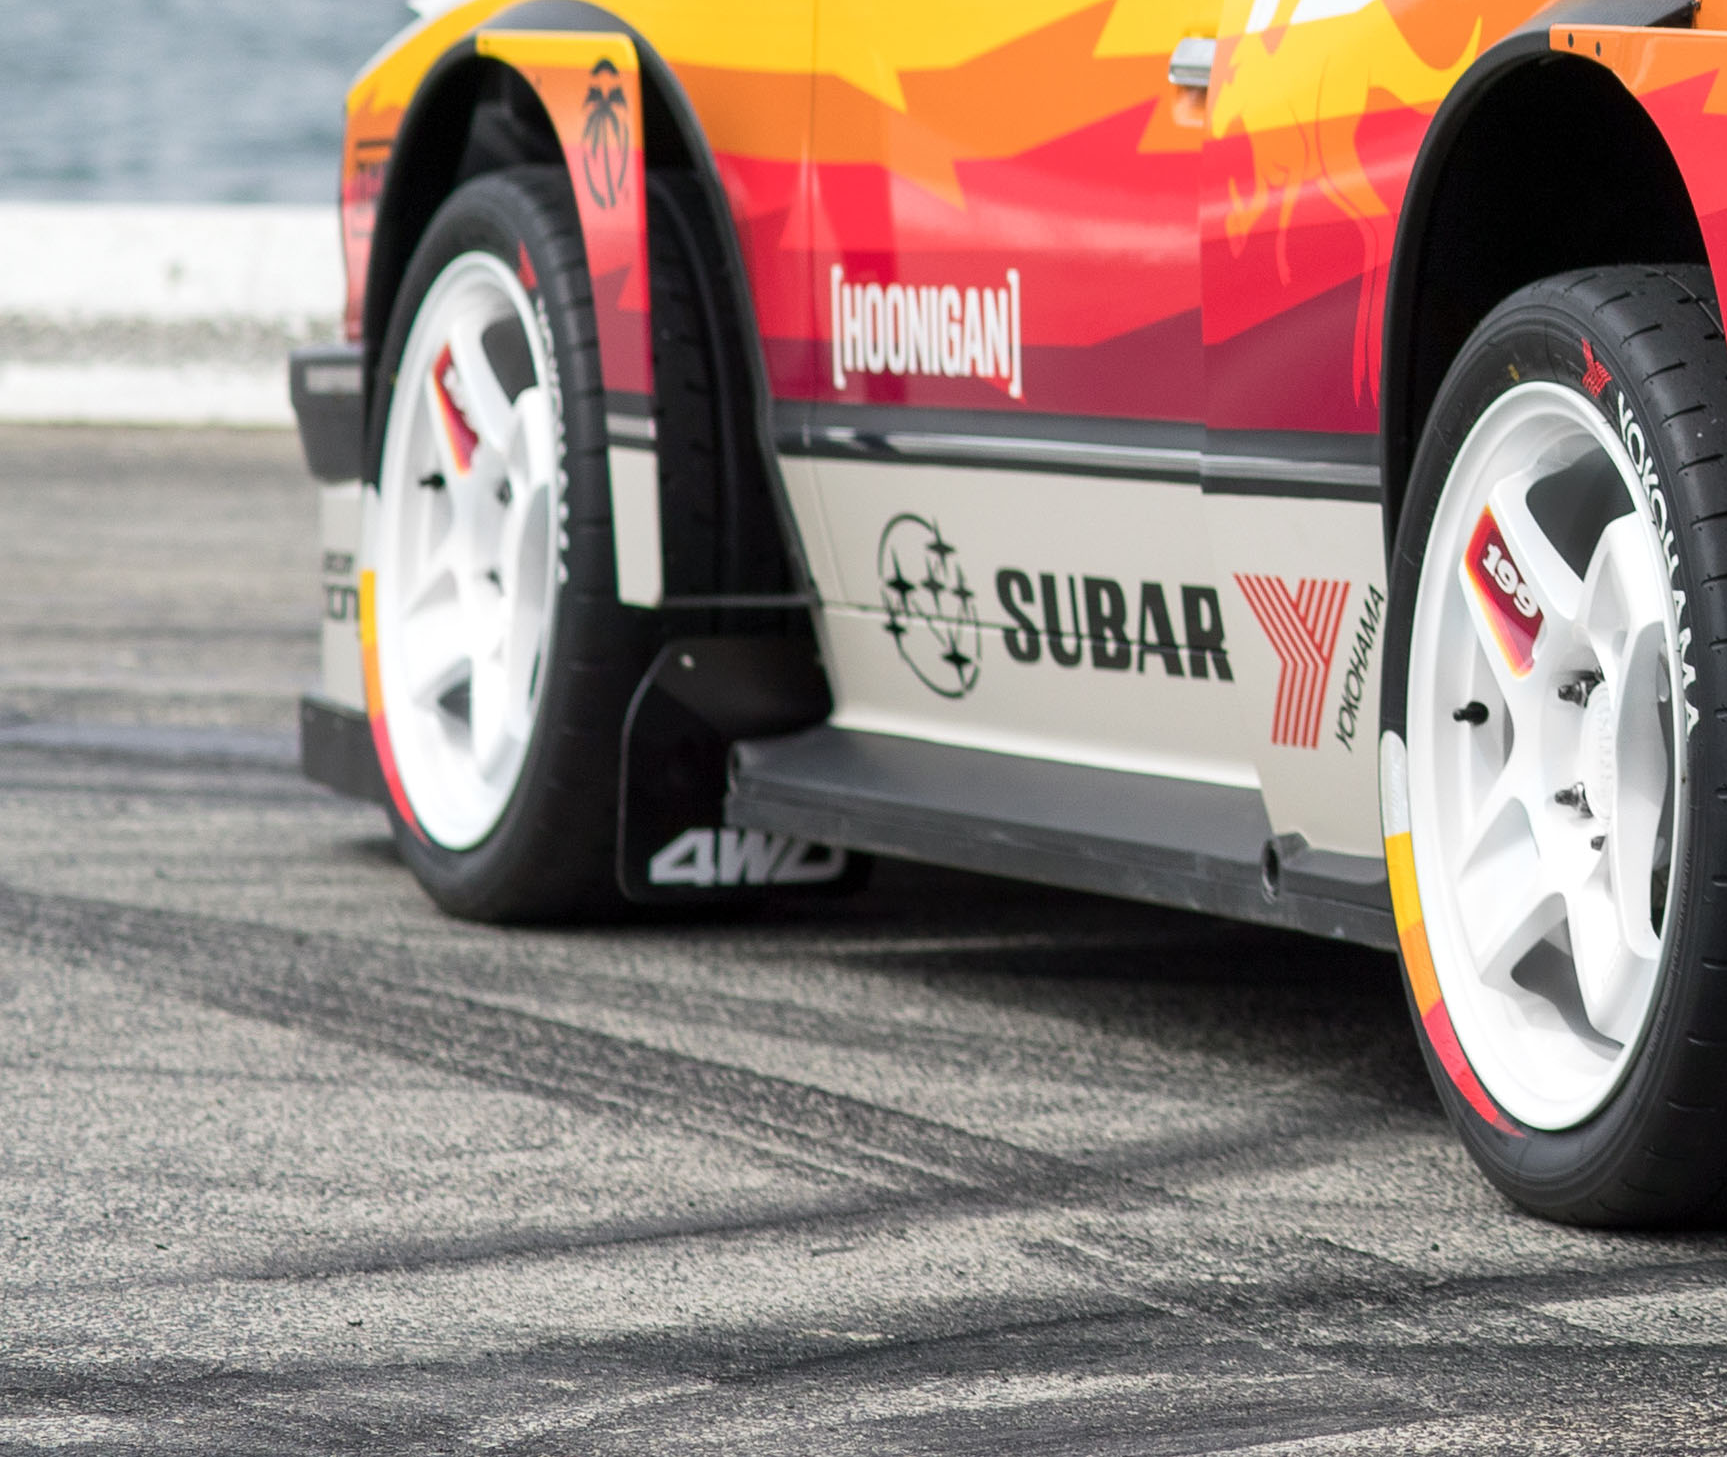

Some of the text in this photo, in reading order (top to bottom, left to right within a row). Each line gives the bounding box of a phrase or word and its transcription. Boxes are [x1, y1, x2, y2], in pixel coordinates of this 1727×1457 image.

[1481, 543, 1540, 618] 199
[1335, 583, 1385, 751] YOKOHAMA
[650, 827, 846, 887] 4WD
